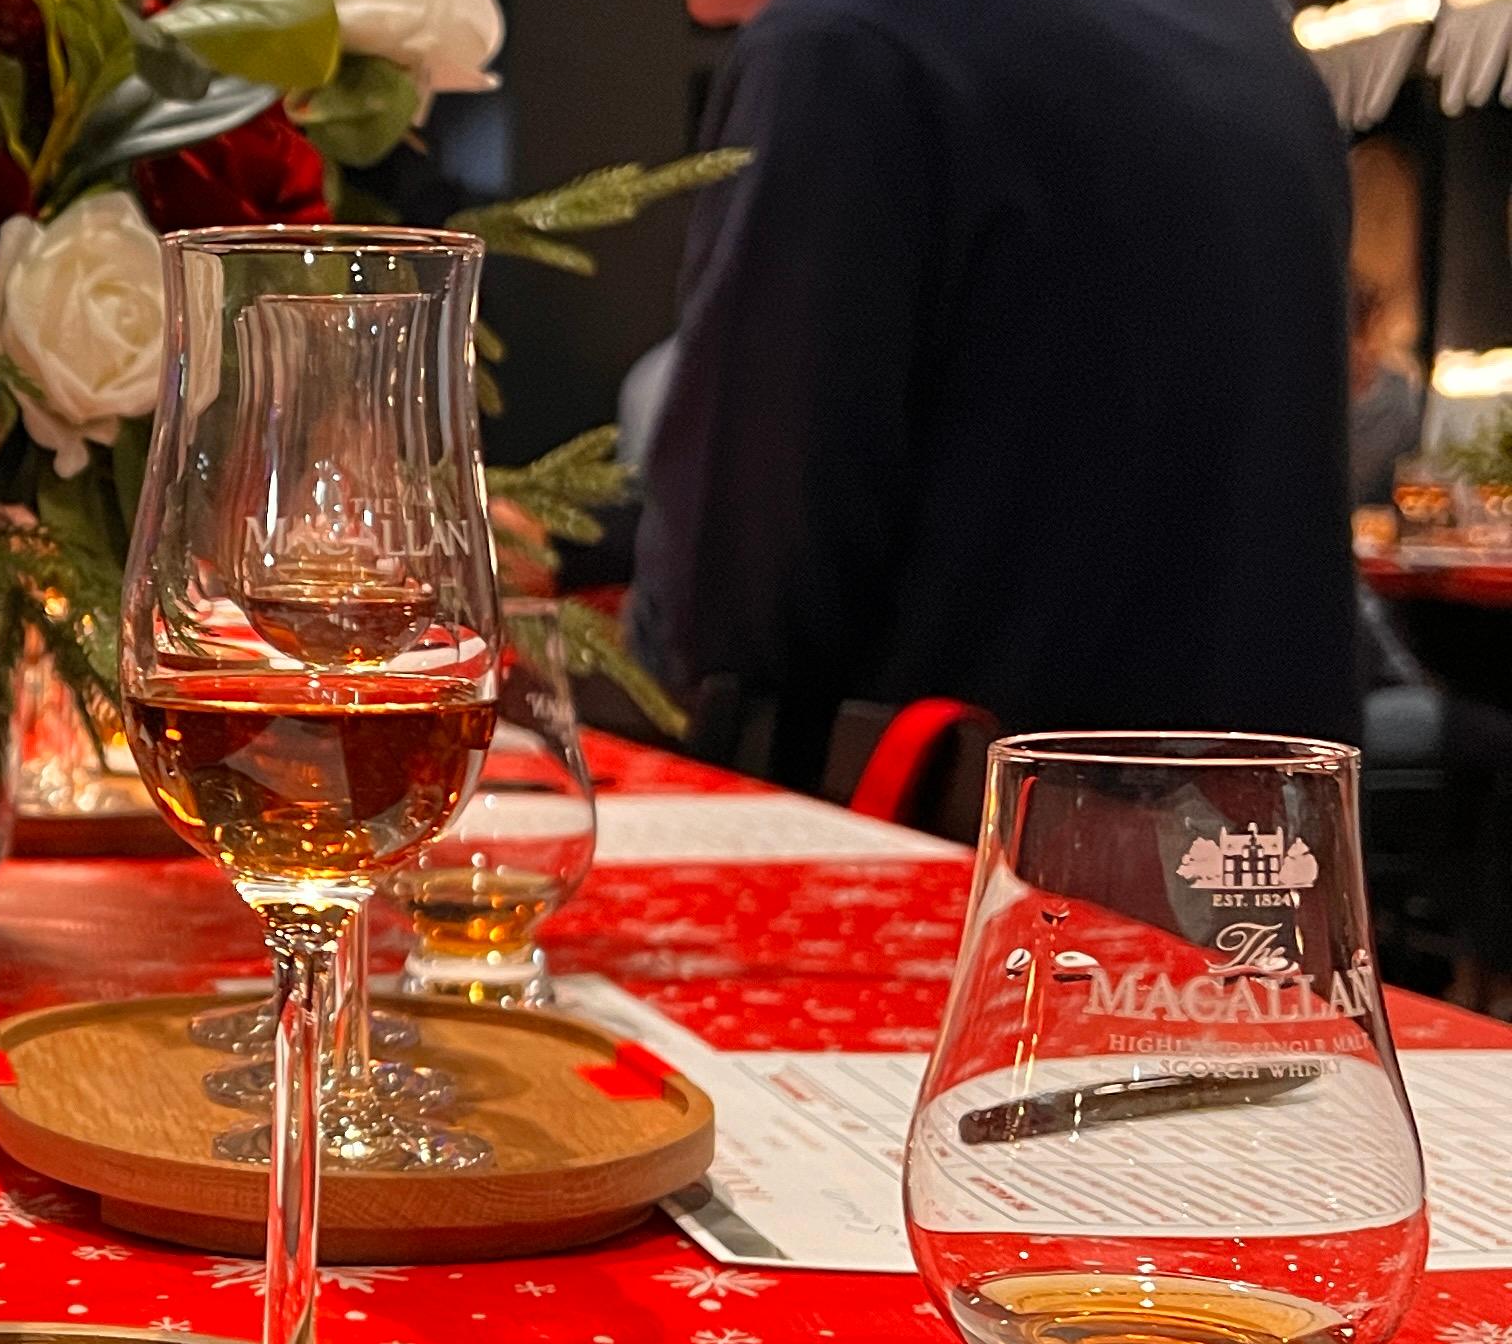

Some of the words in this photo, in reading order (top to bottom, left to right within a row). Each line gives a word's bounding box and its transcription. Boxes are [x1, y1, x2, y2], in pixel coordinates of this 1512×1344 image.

[350, 498, 393, 514] THE
[1212, 893, 1249, 907] EST.
[1255, 893, 1294, 907] 1824
[1204, 922, 1299, 973] The
[1082, 964, 1375, 1024] MACALLAN
[1159, 1058, 1261, 1079] SCOTCH
[1268, 1058, 1344, 1079] WHISKY
